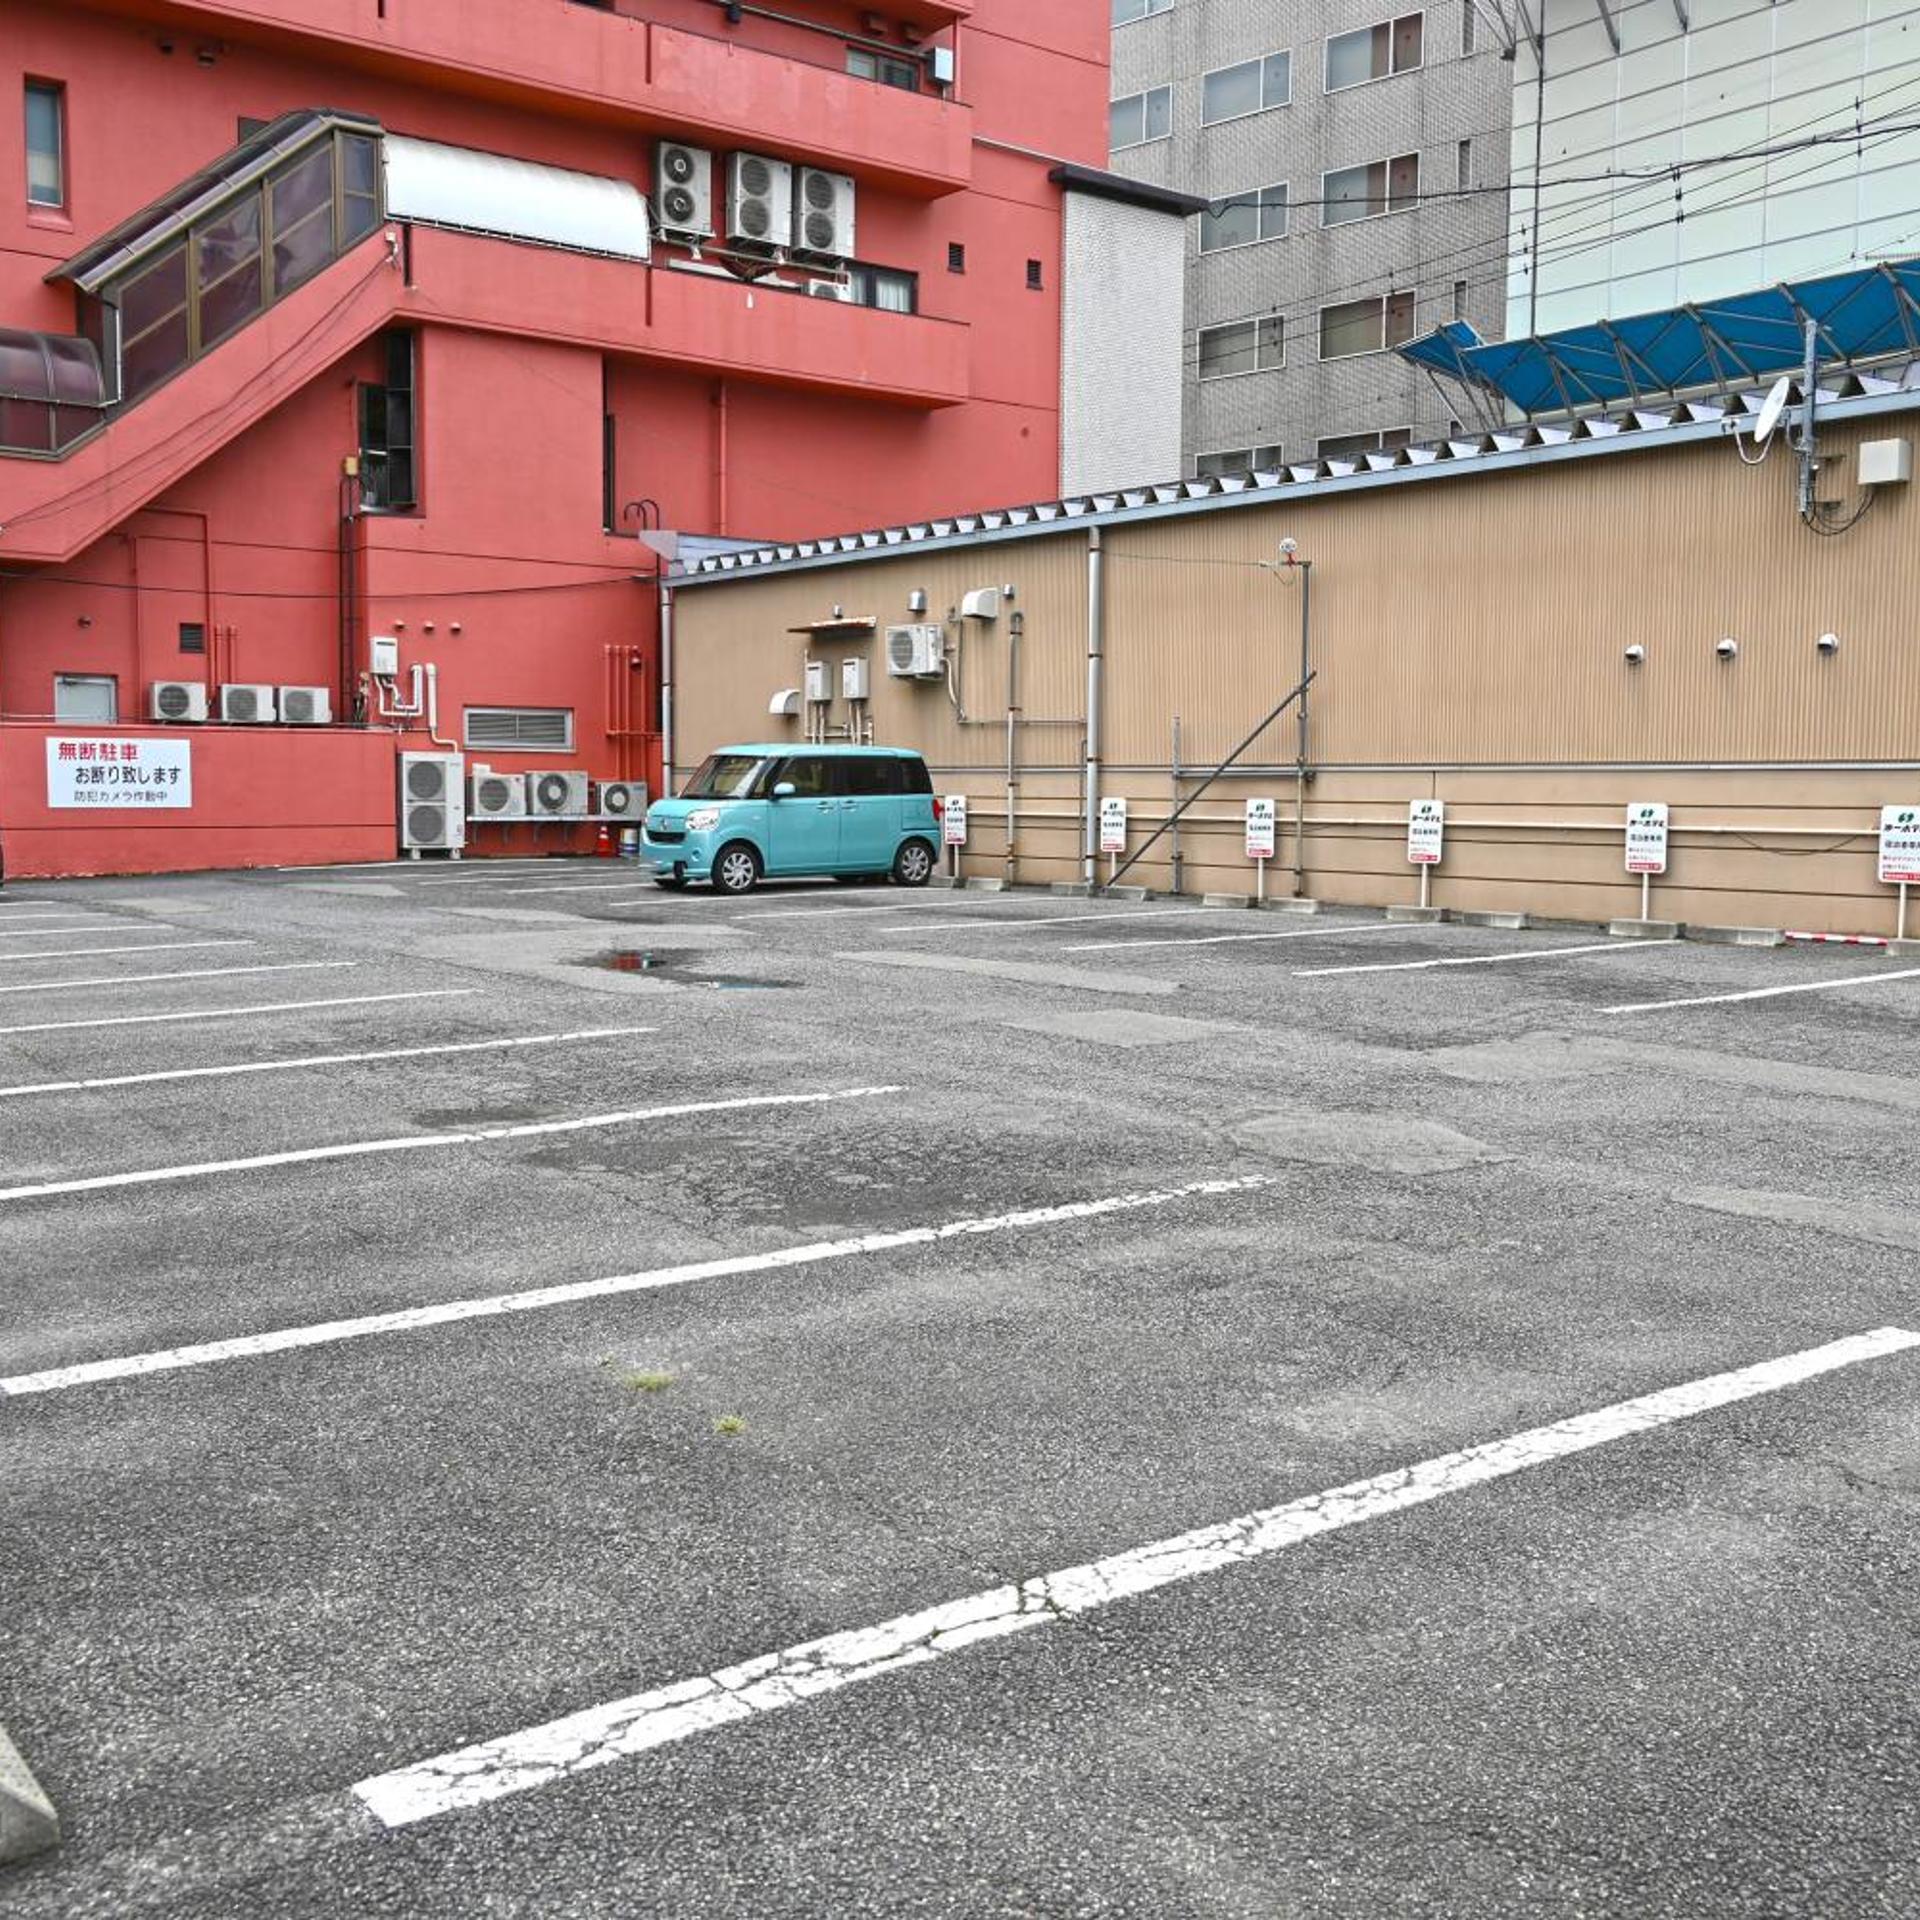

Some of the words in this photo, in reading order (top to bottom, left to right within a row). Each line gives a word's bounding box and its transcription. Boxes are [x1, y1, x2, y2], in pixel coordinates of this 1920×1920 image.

[58, 742, 140, 761] 無断駐車
[75, 765, 182, 785] お断り致します
